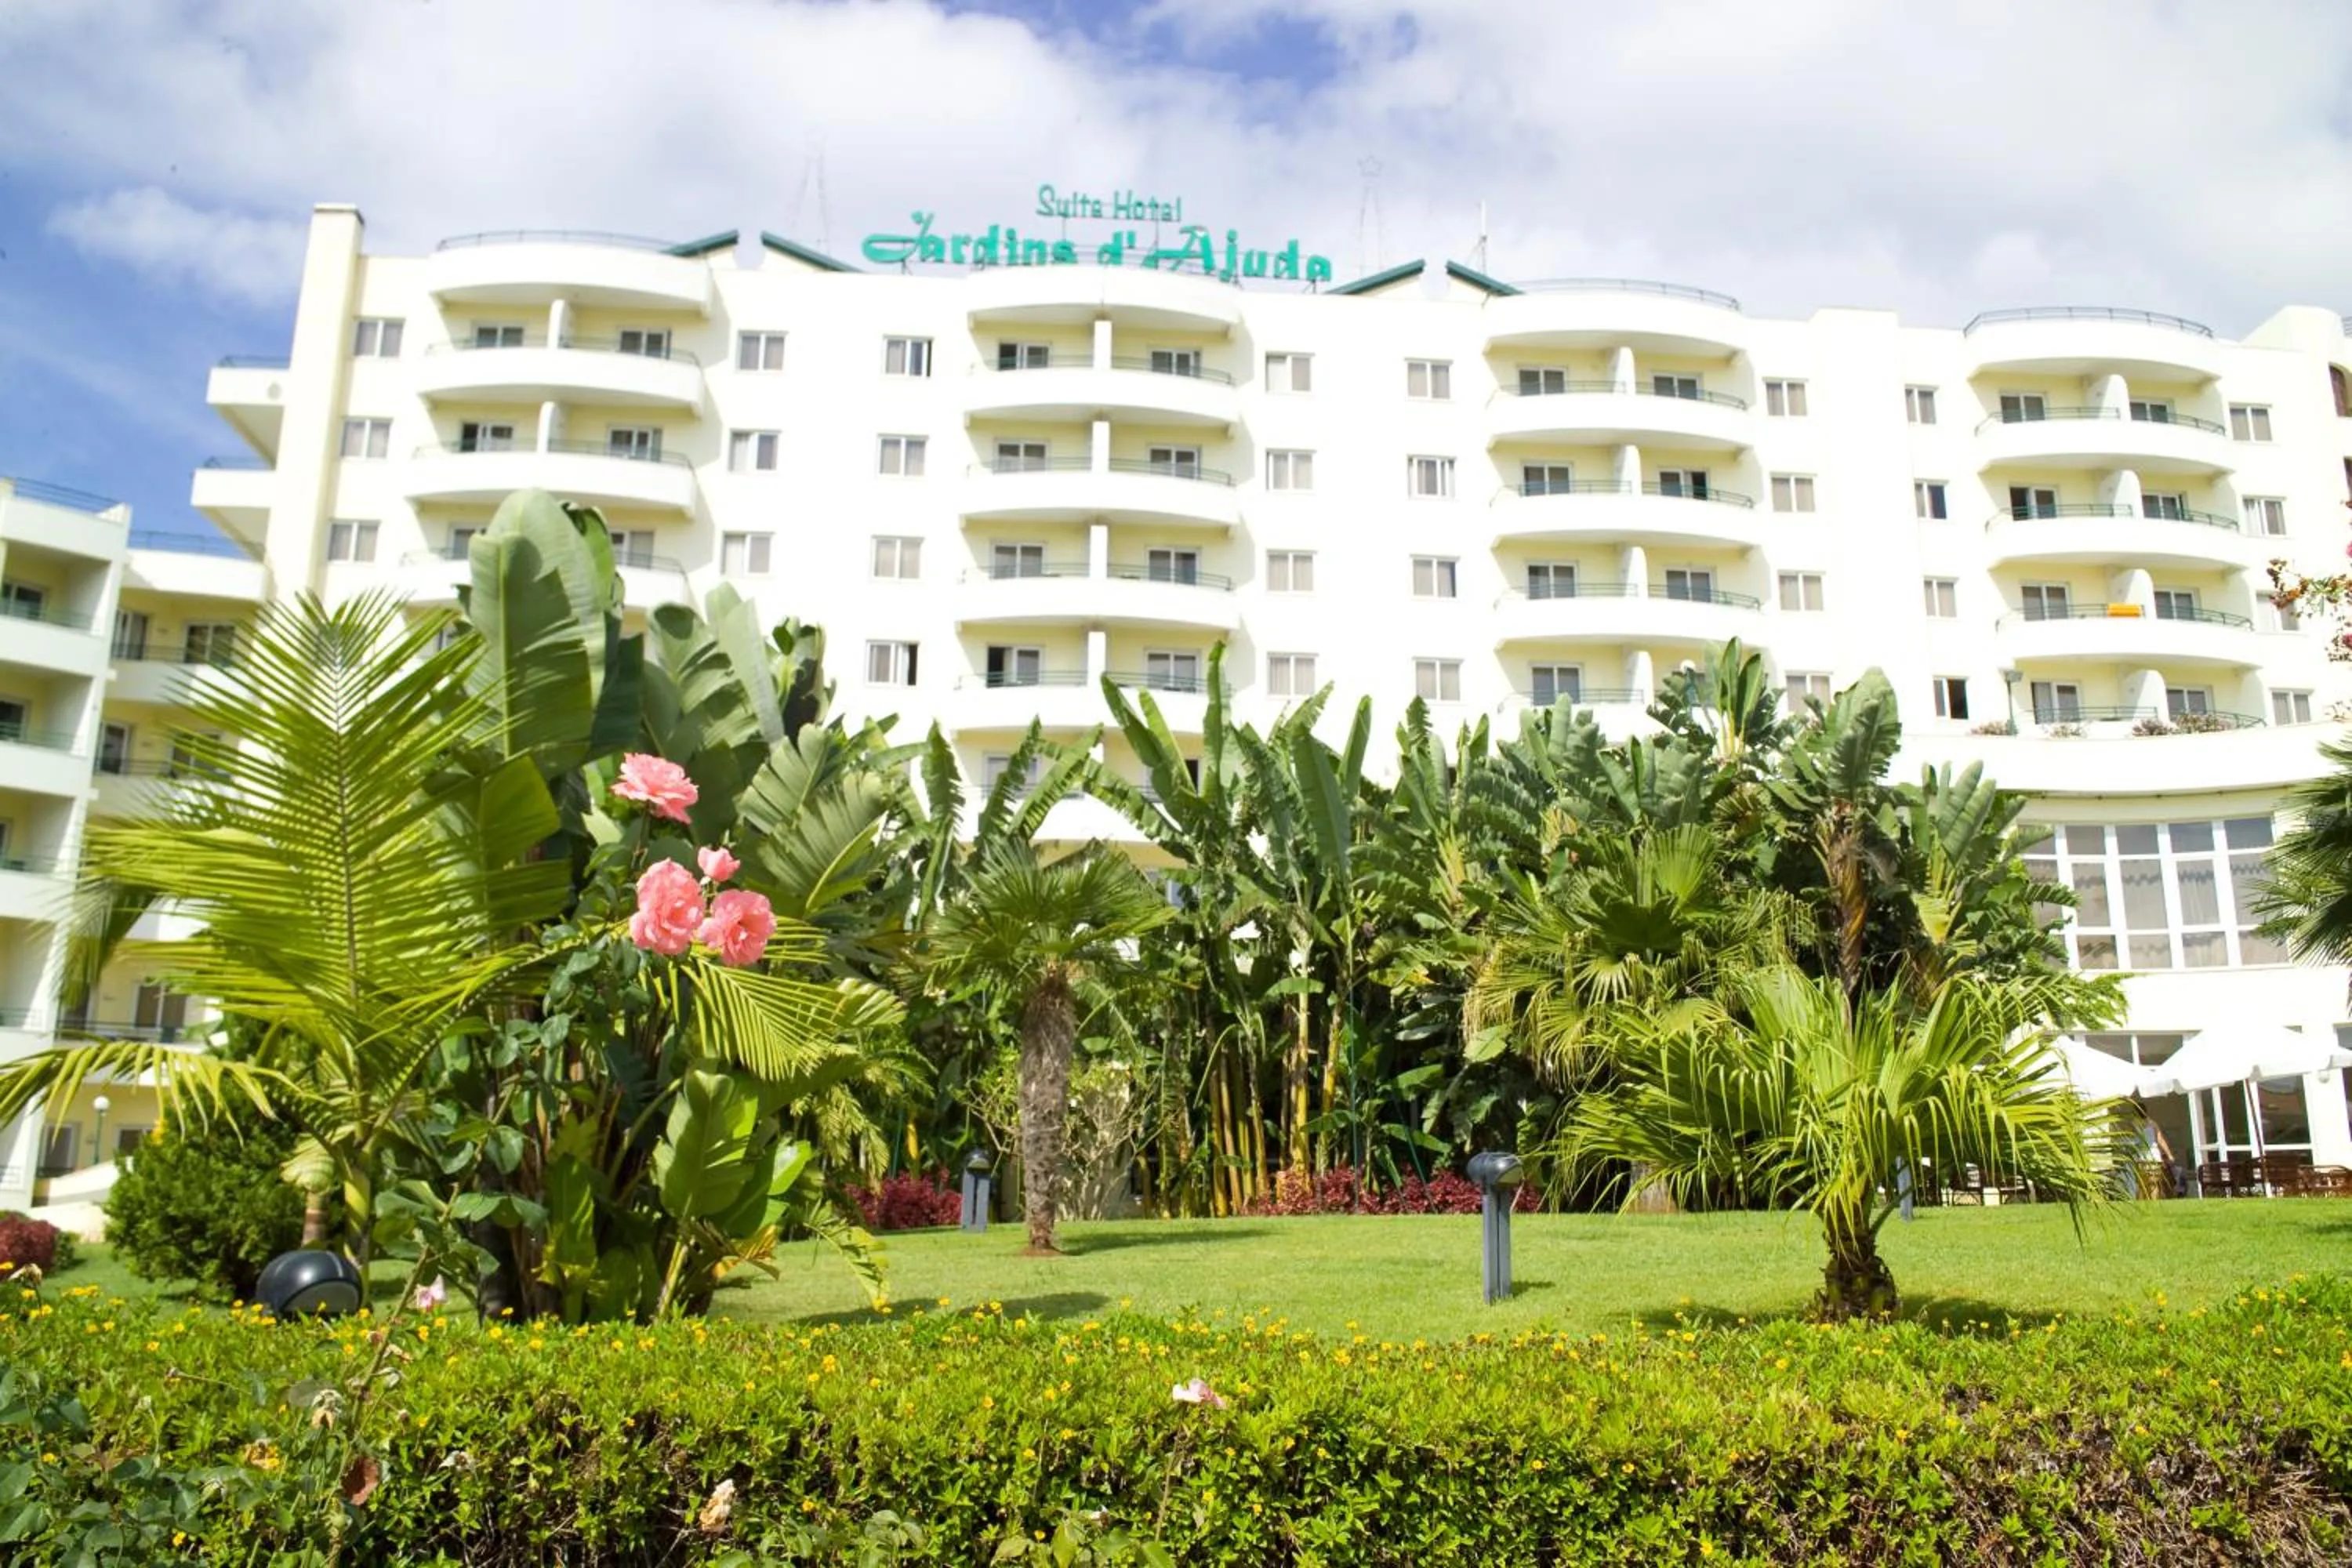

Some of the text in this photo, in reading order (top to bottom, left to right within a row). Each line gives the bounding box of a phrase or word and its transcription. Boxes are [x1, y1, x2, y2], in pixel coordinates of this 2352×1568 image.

[1036, 184, 1181, 222] Suite Hotel
[862, 210, 1078, 267] Jardins
